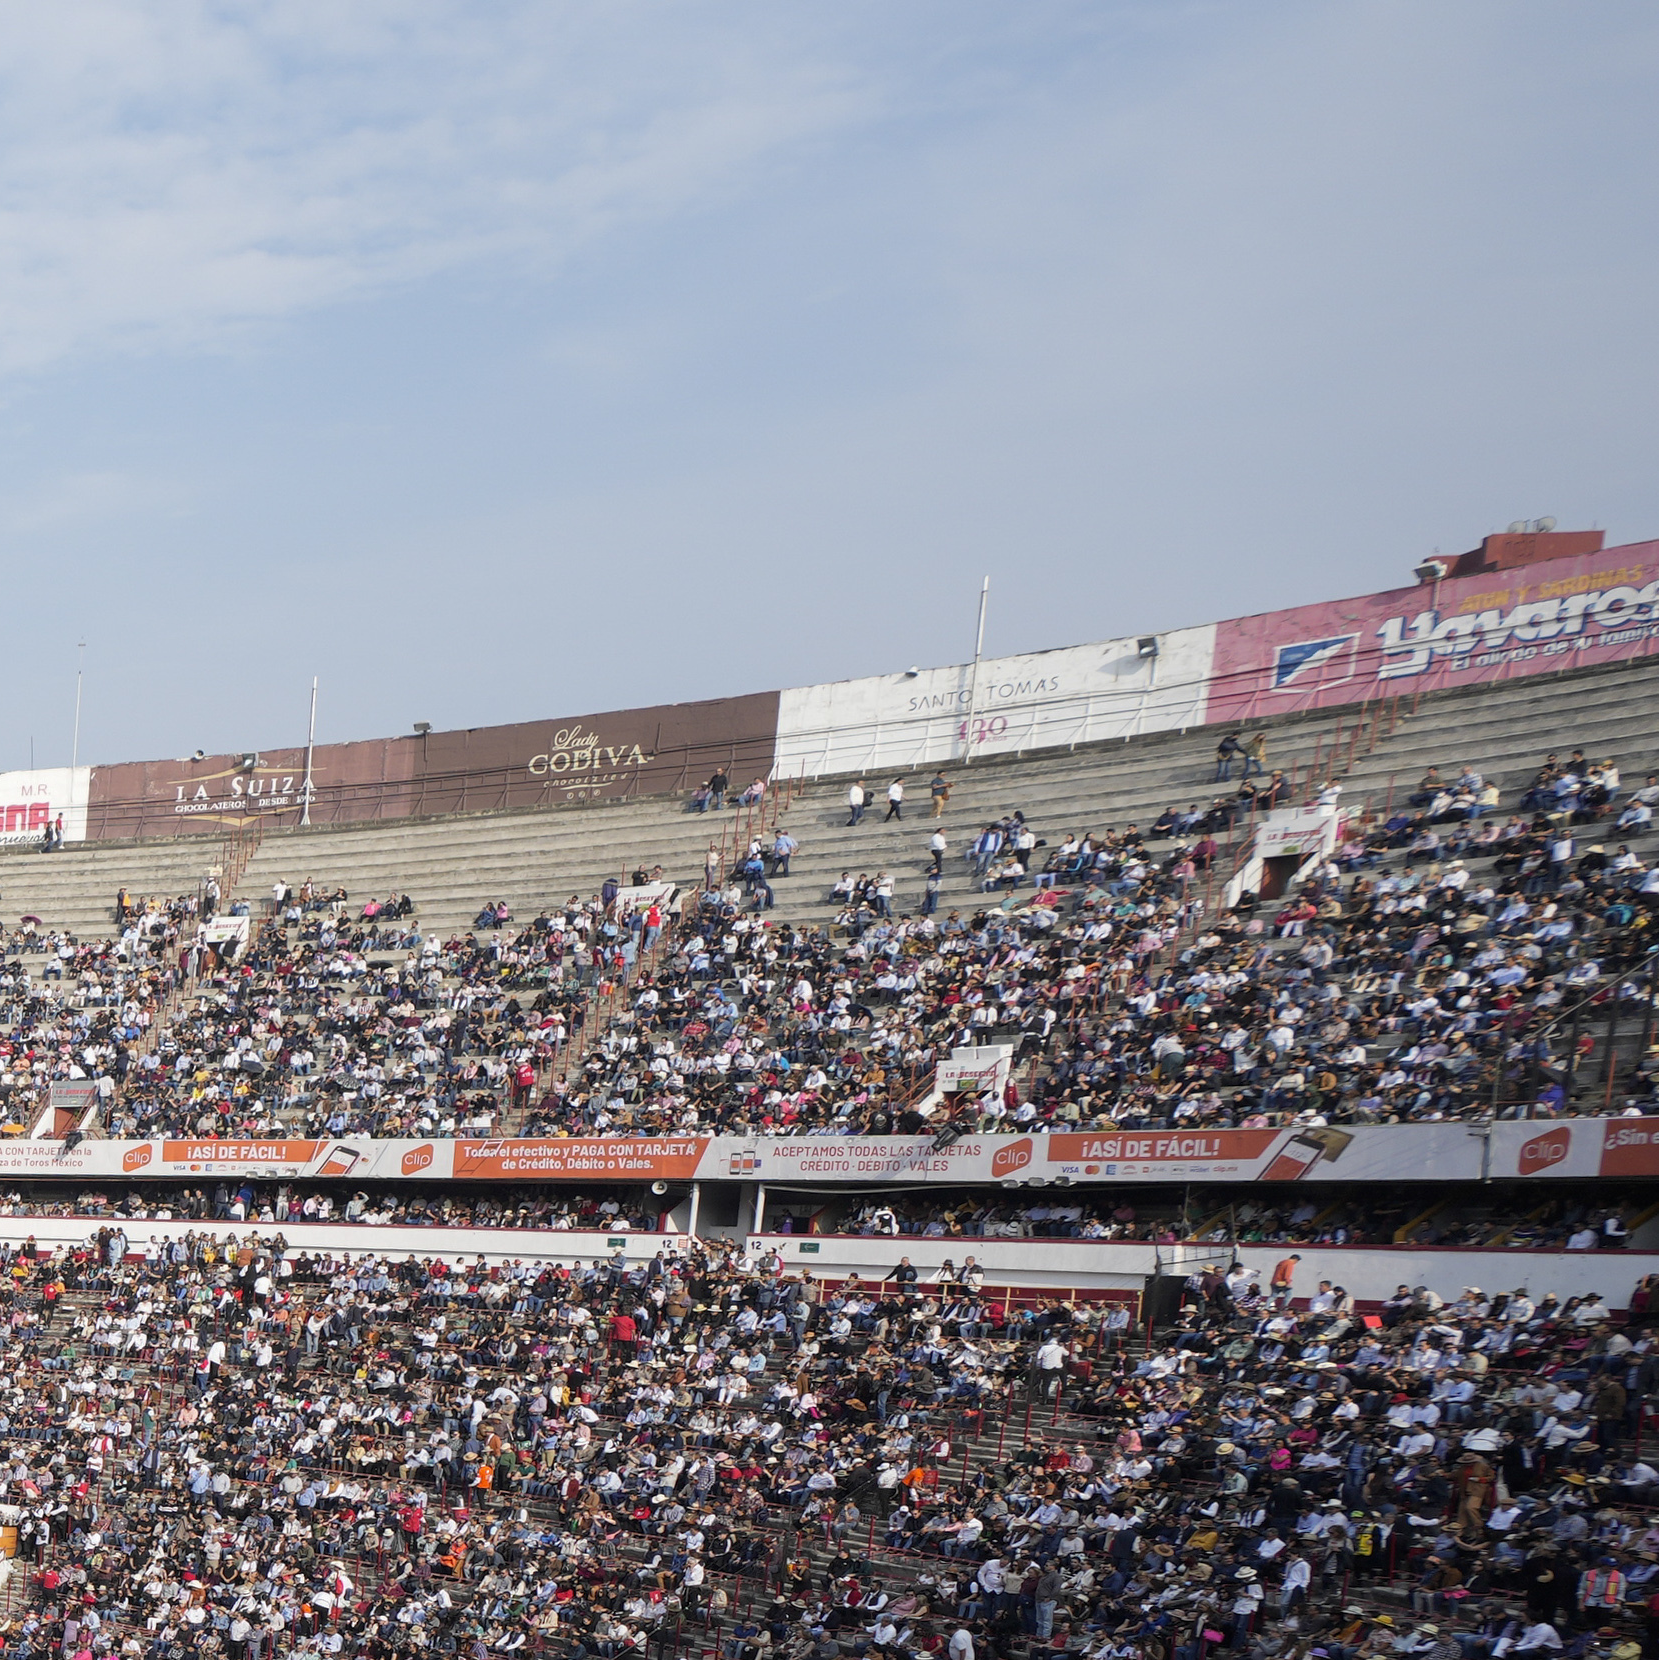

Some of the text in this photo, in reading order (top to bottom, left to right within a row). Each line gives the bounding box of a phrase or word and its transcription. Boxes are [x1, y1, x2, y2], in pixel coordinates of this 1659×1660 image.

[909, 688, 973, 712] SANTO
[552, 725, 599, 751] Lady
[528, 744, 648, 775] GODIVA
[21, 784, 51, 797] M.R.
[175, 776, 317, 803] LA SUIZA
[175, 796, 288, 813] CHOCOLATEROS DESDE
[1605, 1129, 1647, 1150] ¿Sin
[5, 1147, 24, 1156] CON
[188, 1145, 286, 1160] ¡ASÍ DE FÁCIL!
[512, 1143, 695, 1157] efectivo PAGA CON TARJETA
[773, 1145, 981, 1157] ACEPTAMOS TODAS LAS TARJETAS
[1082, 1139, 1220, 1158] ¡ASÍ DE FÁCIL!
[24, 1159, 49, 1167] Toros
[51, 1158, 83, 1168] México
[125, 1152, 150, 1166] clip
[404, 1154, 431, 1168] clip
[518, 1157, 654, 1171] Crédito, Débito Vales.
[800, 1158, 949, 1171] CRÉDITO DÉBITO VALES
[996, 1149, 1028, 1166] clip
[1062, 1166, 1079, 1174] VISA
[662, 1238, 672, 1249] 12
[751, 1241, 762, 1250] 12
